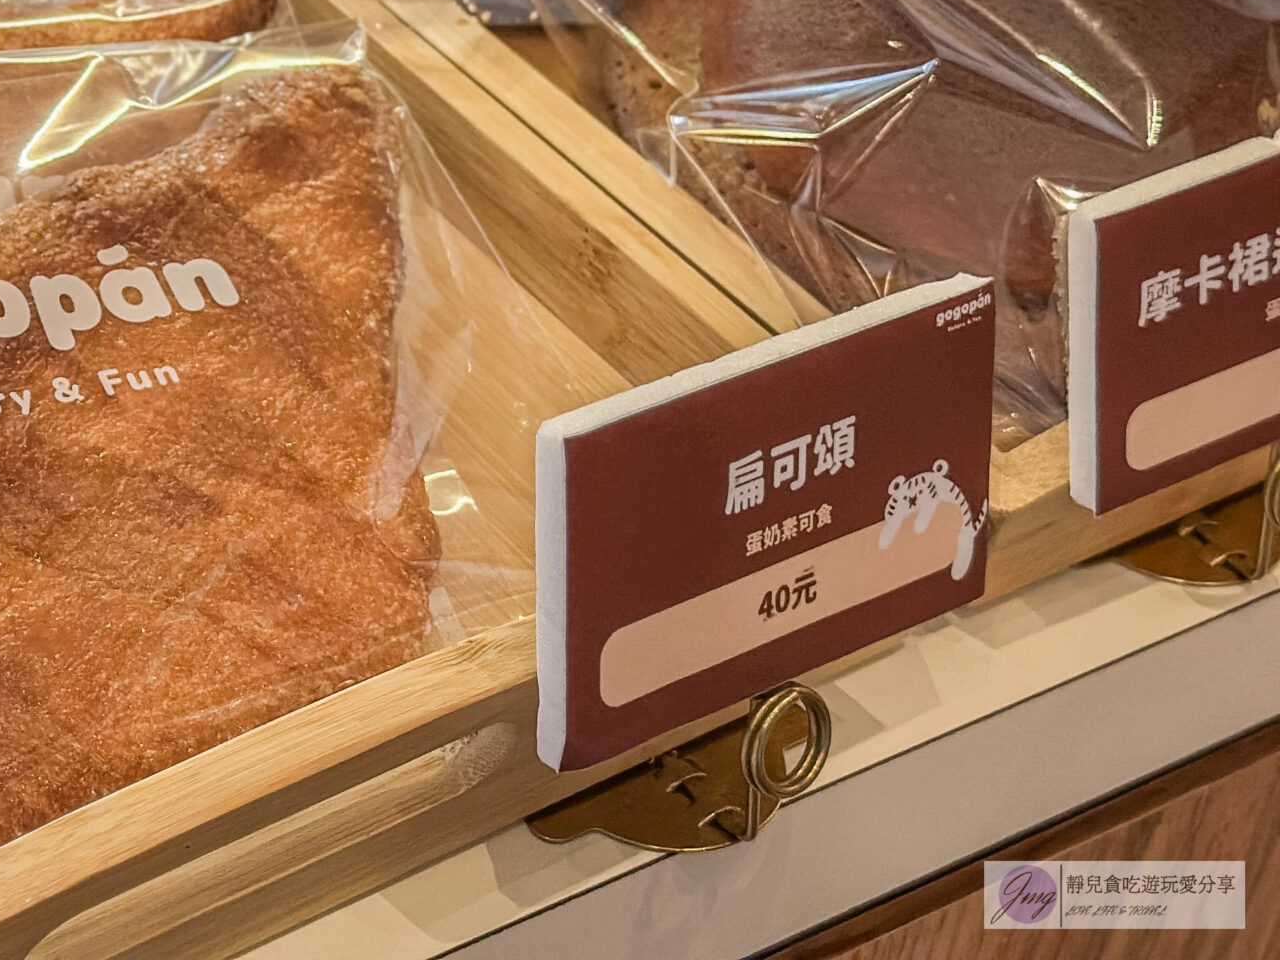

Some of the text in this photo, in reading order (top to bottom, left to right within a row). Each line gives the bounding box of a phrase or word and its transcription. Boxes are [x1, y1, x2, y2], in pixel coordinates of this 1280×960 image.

[1138, 227, 1280, 328] 摩卡裙
[52, 375, 85, 404] &
[97, 363, 181, 396] Fun
[725, 415, 857, 516] 扁可頌
[746, 503, 833, 558] 蛋奶素可食
[757, 571, 818, 619] 40元
